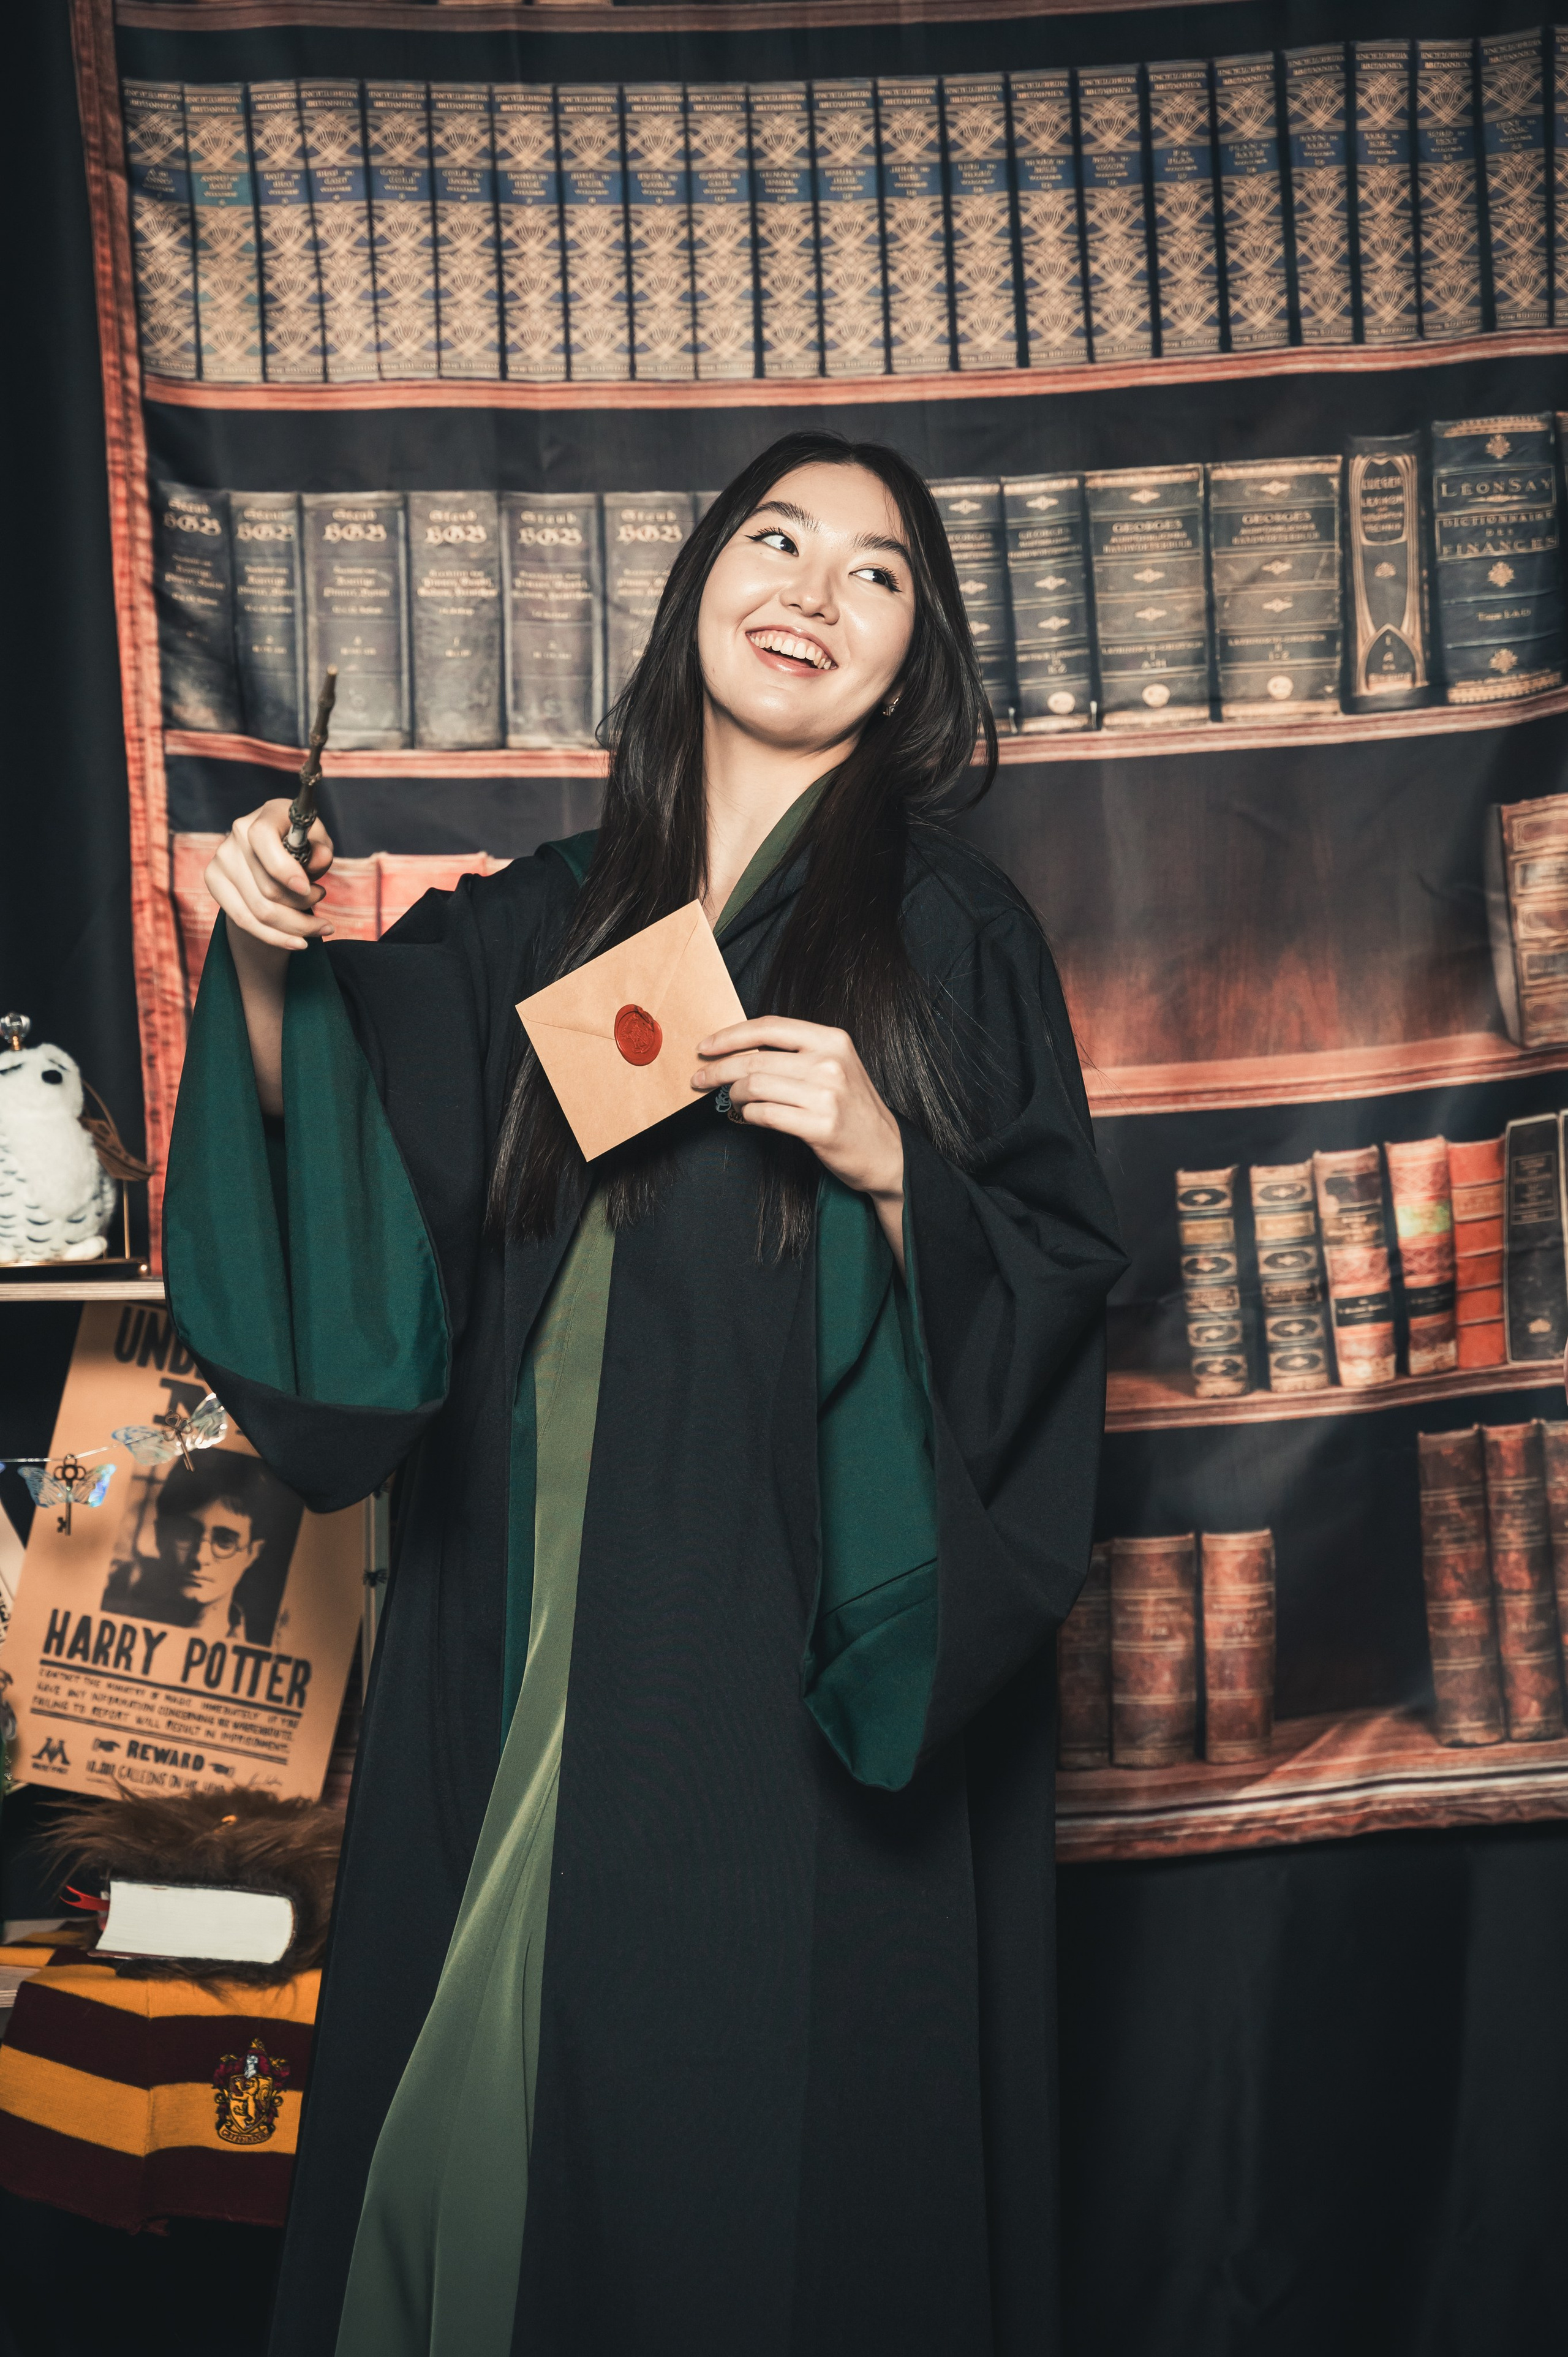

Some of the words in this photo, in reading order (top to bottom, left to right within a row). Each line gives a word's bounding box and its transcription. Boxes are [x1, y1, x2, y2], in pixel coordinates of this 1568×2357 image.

[1442, 535, 1557, 556] FINANCES
[115, 1306, 206, 1381] UND
[42, 1608, 167, 1676] HARRY
[179, 1636, 313, 1709] POTTER
[126, 1740, 205, 1771] REWARD
